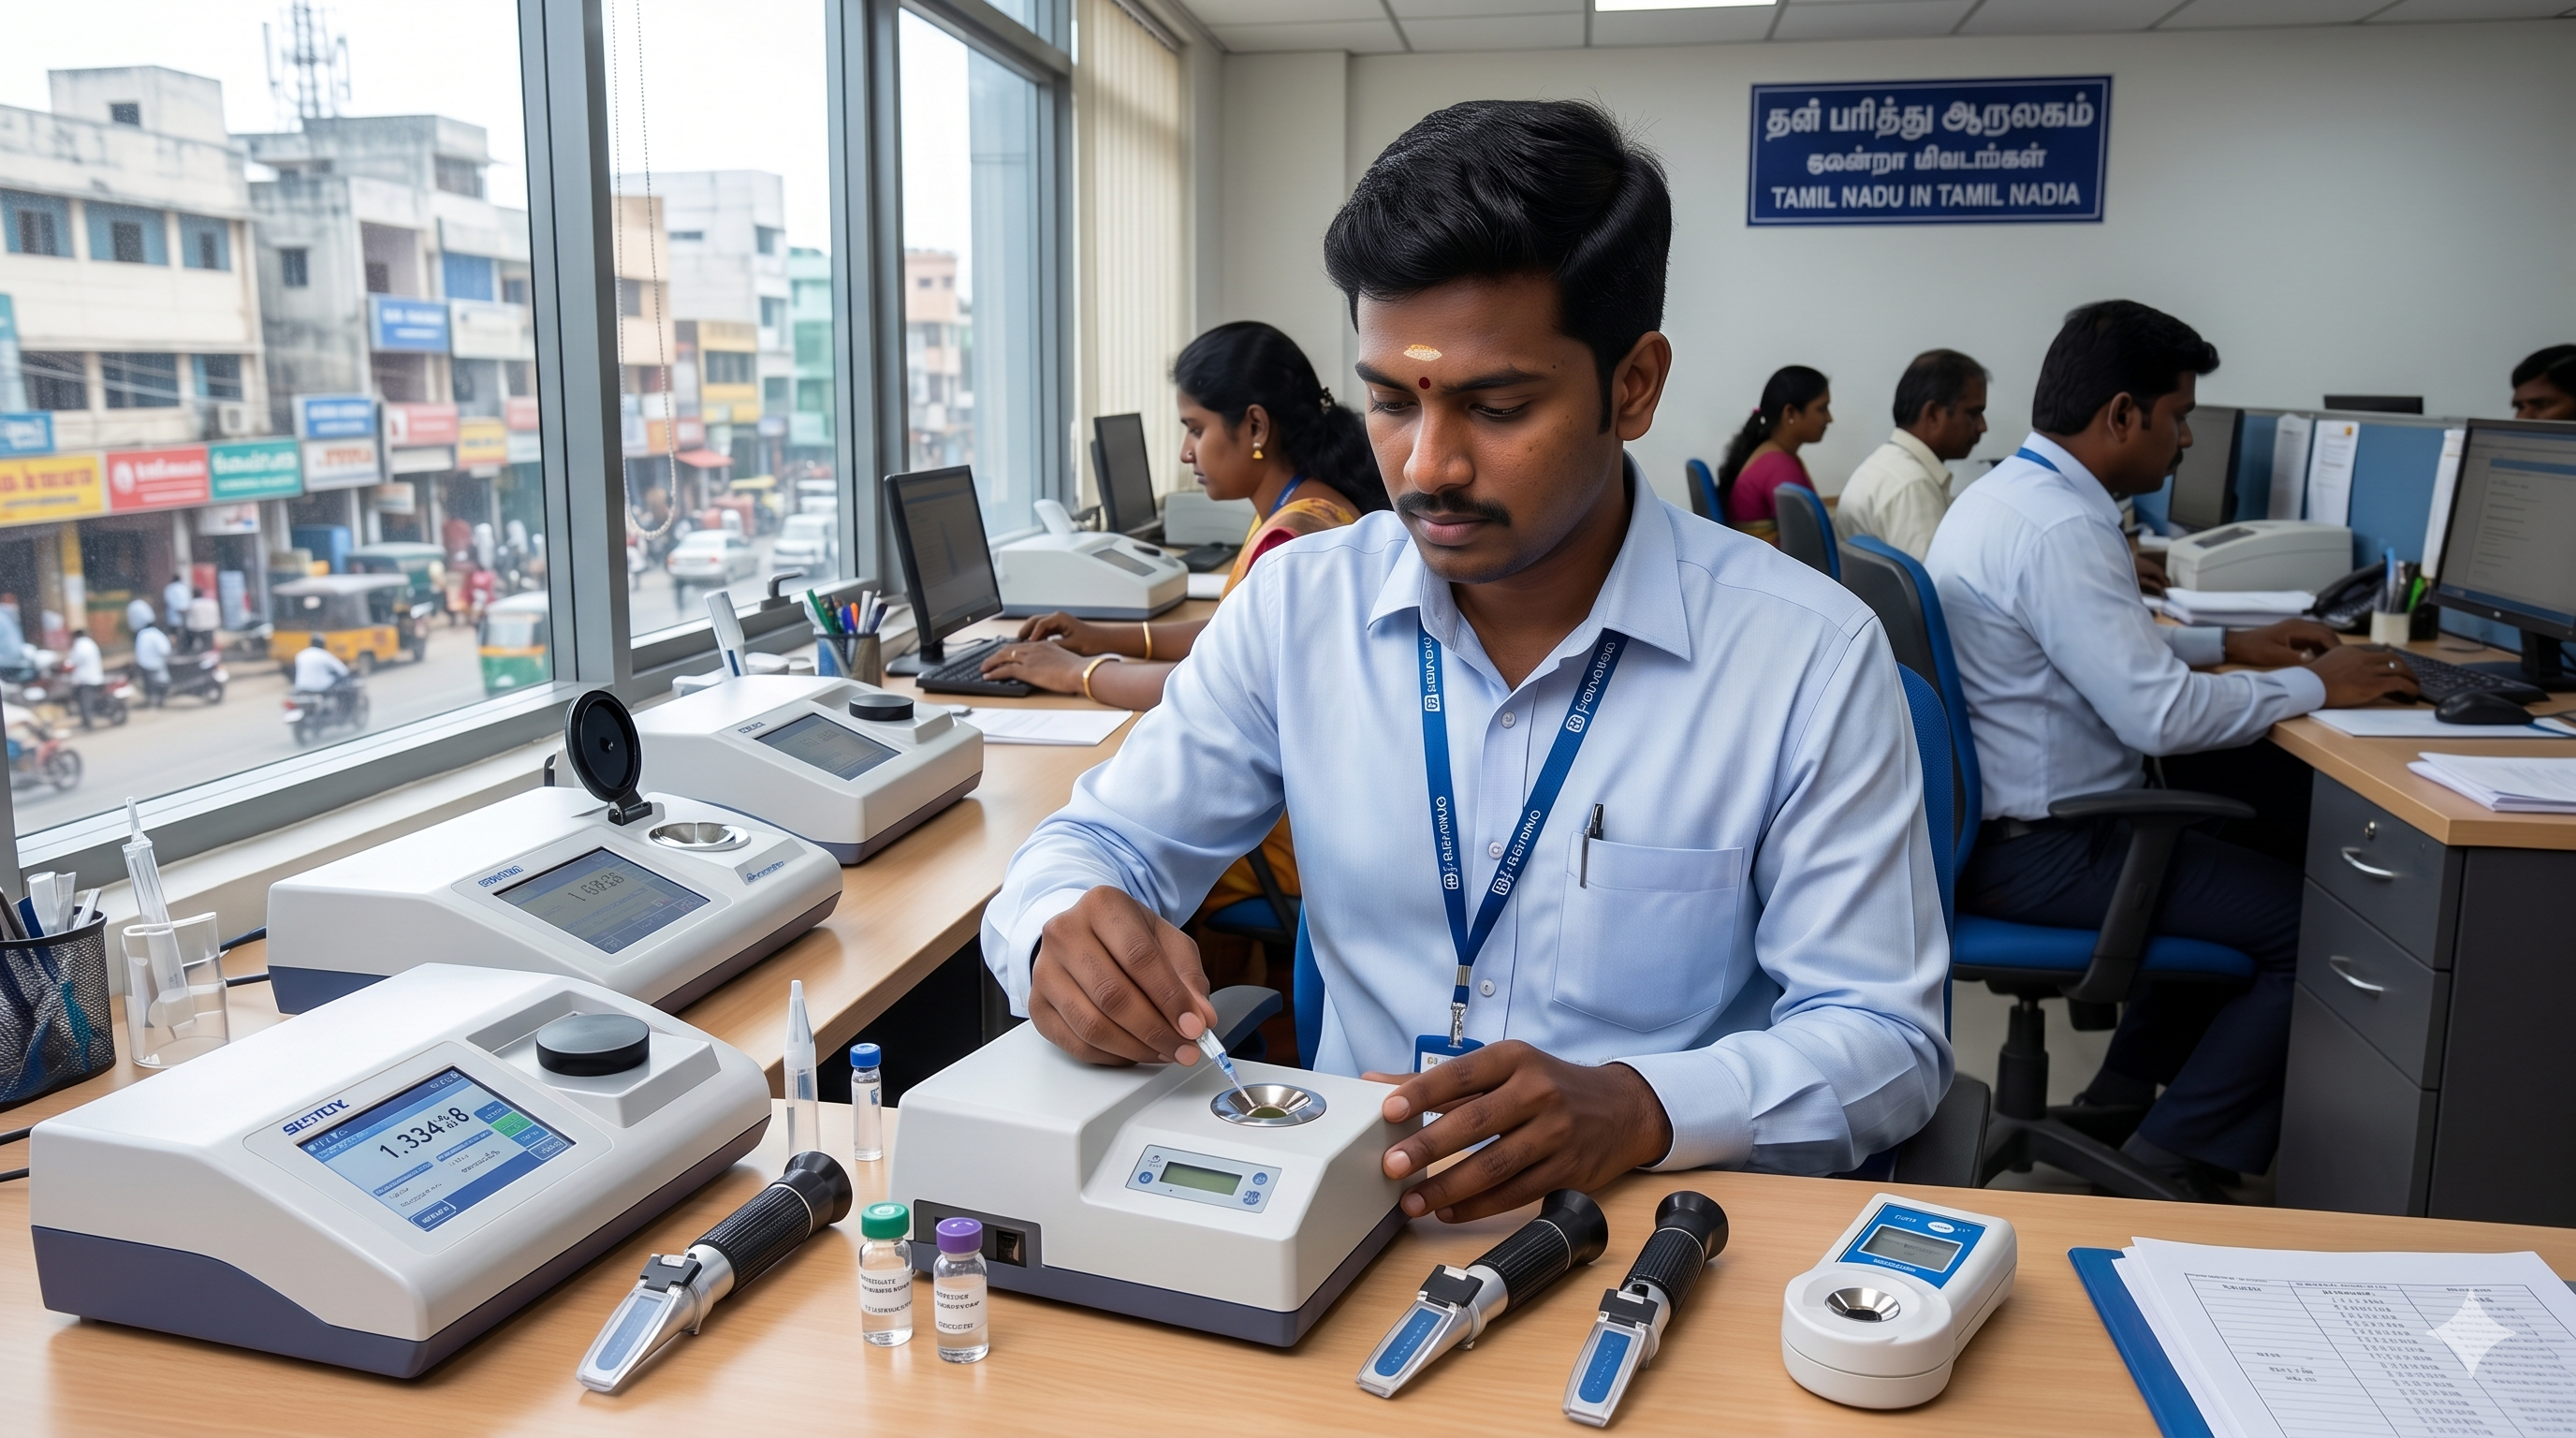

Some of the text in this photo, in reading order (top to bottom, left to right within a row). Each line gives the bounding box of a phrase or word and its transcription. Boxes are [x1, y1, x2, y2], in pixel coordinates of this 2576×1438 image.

[1770, 182, 2081, 209] TAMIL NADU IN TAMIL NADIA
